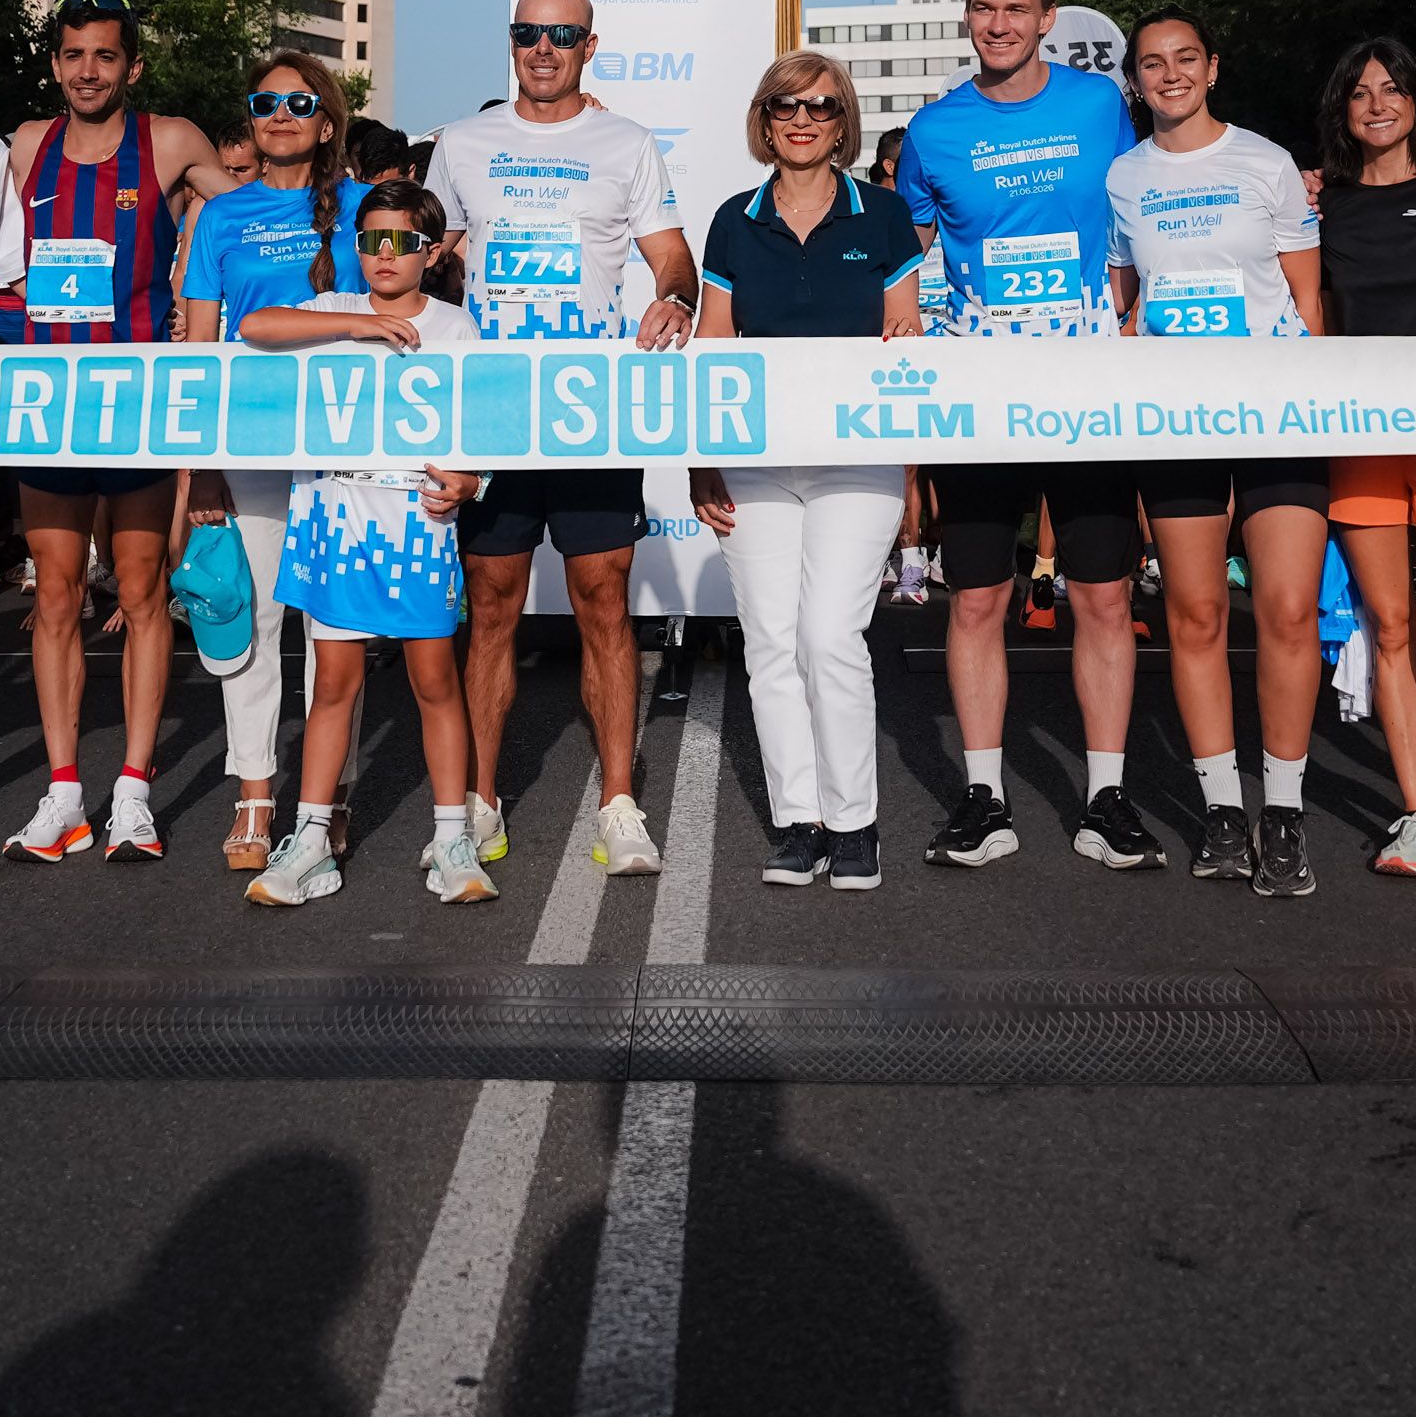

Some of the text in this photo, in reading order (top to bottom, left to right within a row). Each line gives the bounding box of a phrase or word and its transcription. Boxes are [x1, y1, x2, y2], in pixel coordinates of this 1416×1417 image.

[631, 52, 695, 81] BM
[970, 134, 1077, 157] KLM Royal Dutch Airlines
[490, 155, 590, 169] KLM Royal Dutch Airlines
[972, 144, 1080, 172] NORTE VS SUR
[489, 166, 589, 182] NORTE VS SUR
[995, 166, 1064, 190] Run Well
[503, 185, 570, 200] Run Well
[1009, 183, 1055, 198] 21.06.2026
[1140, 183, 1239, 203] KLM Royal Dutch Airlines
[513, 200, 557, 210] 21.06.2026
[1141, 193, 1240, 216] NORTE VS SUR
[242, 224, 267, 235] KLM
[494, 221, 510, 229] KLM
[1157, 213, 1223, 232] Run Well
[1168, 229, 1212, 240] 21.06.2026
[259, 242, 293, 257] Run
[992, 248, 1072, 264] NORTE VS SUR
[490, 250, 576, 277] 1774
[60, 273, 80, 299] 4
[1002, 268, 1068, 298] 232
[1163, 305, 1230, 333] 233
[318, 365, 445, 444] VS
[551, 364, 752, 443] SUR
[835, 402, 976, 439] KLM
[1007, 401, 1122, 445] Royal
[1136, 400, 1264, 437] Dutch
[646, 518, 700, 541] DRID
